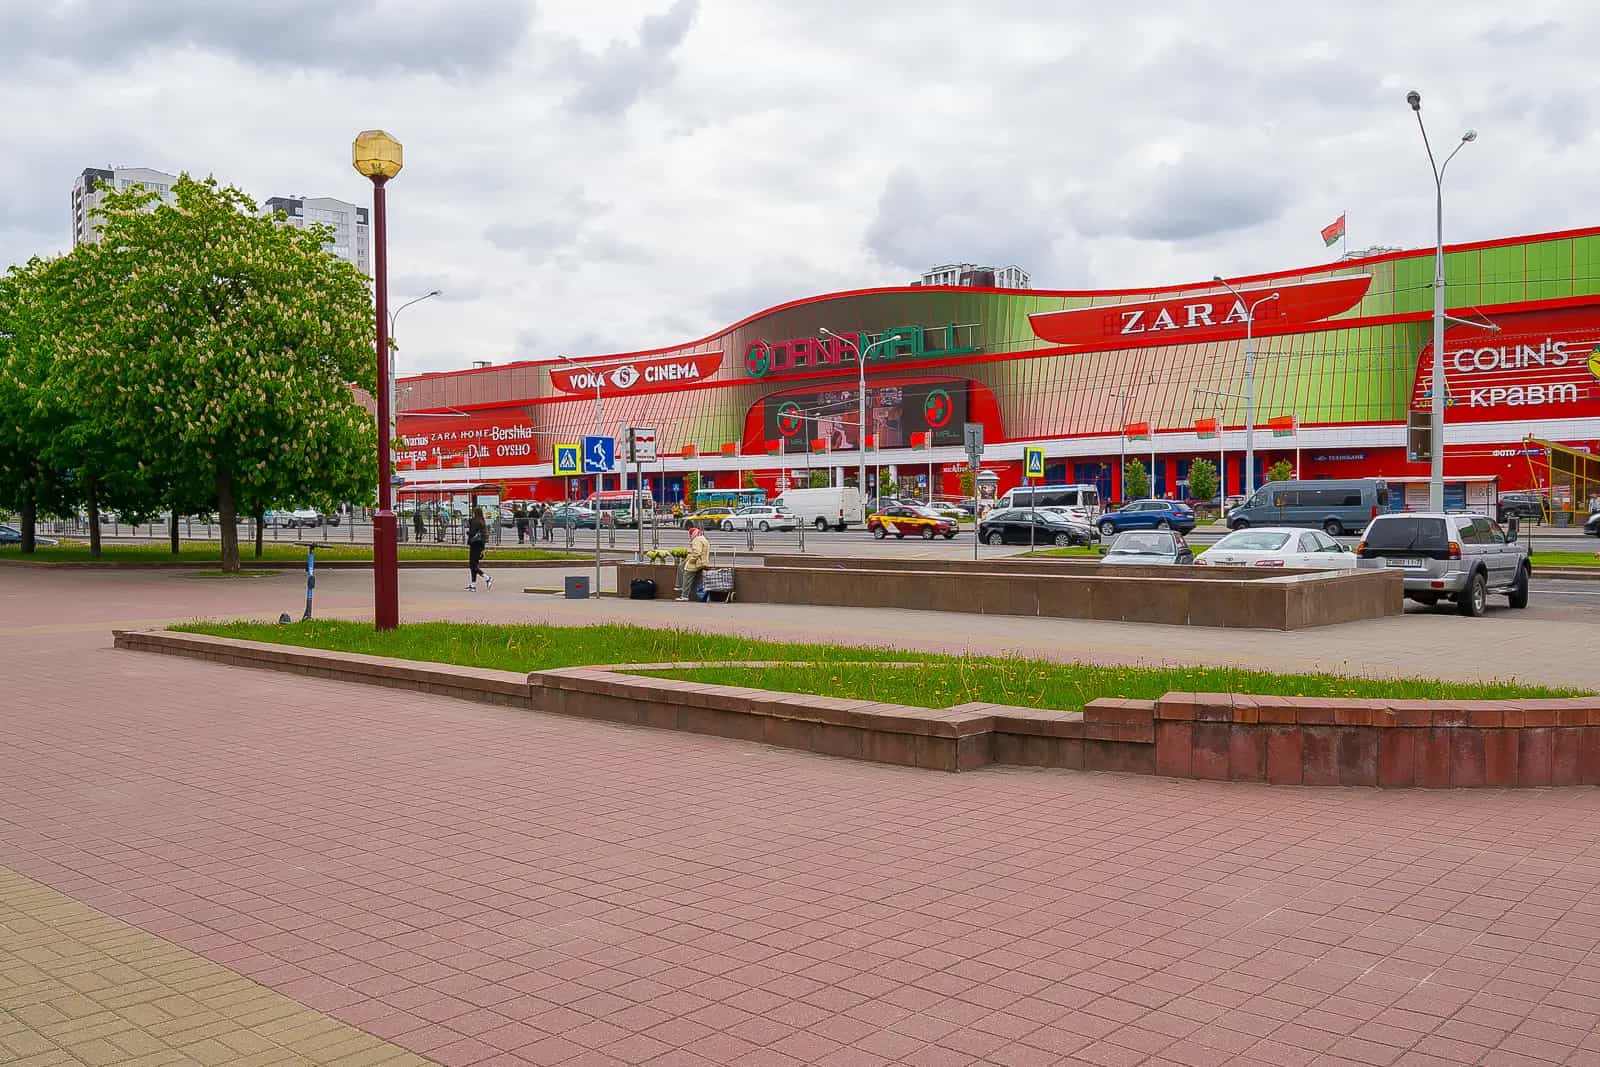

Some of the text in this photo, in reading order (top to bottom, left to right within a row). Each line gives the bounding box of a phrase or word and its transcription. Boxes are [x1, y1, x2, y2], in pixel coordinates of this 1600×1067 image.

[1120, 299, 1255, 335] ZARA
[1454, 337, 1569, 372] COLIN'S
[569, 371, 606, 389] VOKA
[644, 361, 700, 383] CINEMA
[431, 432, 457, 441] ZARA
[492, 424, 532, 441] Bershka
[496, 443, 531, 457] OYSHO
